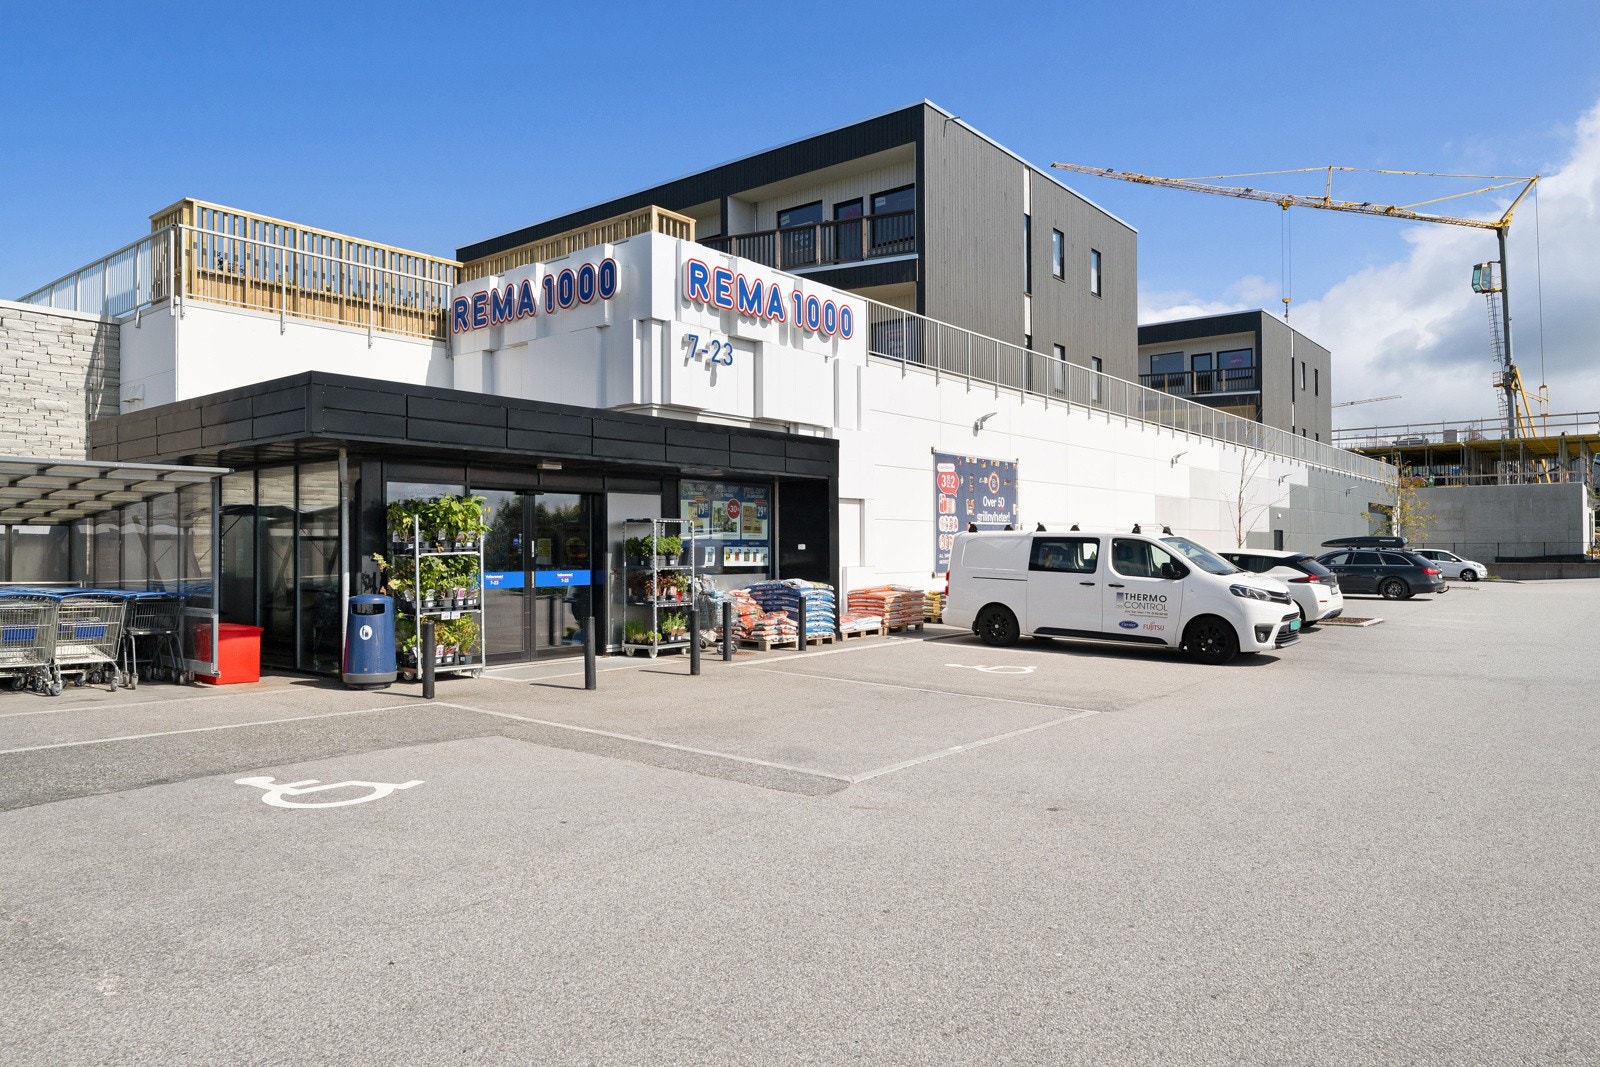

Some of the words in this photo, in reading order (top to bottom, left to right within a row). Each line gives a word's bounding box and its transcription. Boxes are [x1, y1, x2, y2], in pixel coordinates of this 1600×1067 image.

[452, 279, 536, 334] REMA
[542, 258, 617, 314] 1000
[688, 258, 786, 323] REMA
[792, 290, 853, 340] 1000
[688, 333, 733, 366] 7-23
[941, 474, 947, 488] 3
[950, 475, 956, 488] 2
[982, 496, 997, 507] Over
[997, 497, 1005, 508] 50
[1125, 593, 1167, 603] THERMO
[1124, 601, 1168, 611] CONTROL
[1143, 623, 1165, 631] FUJITSU
